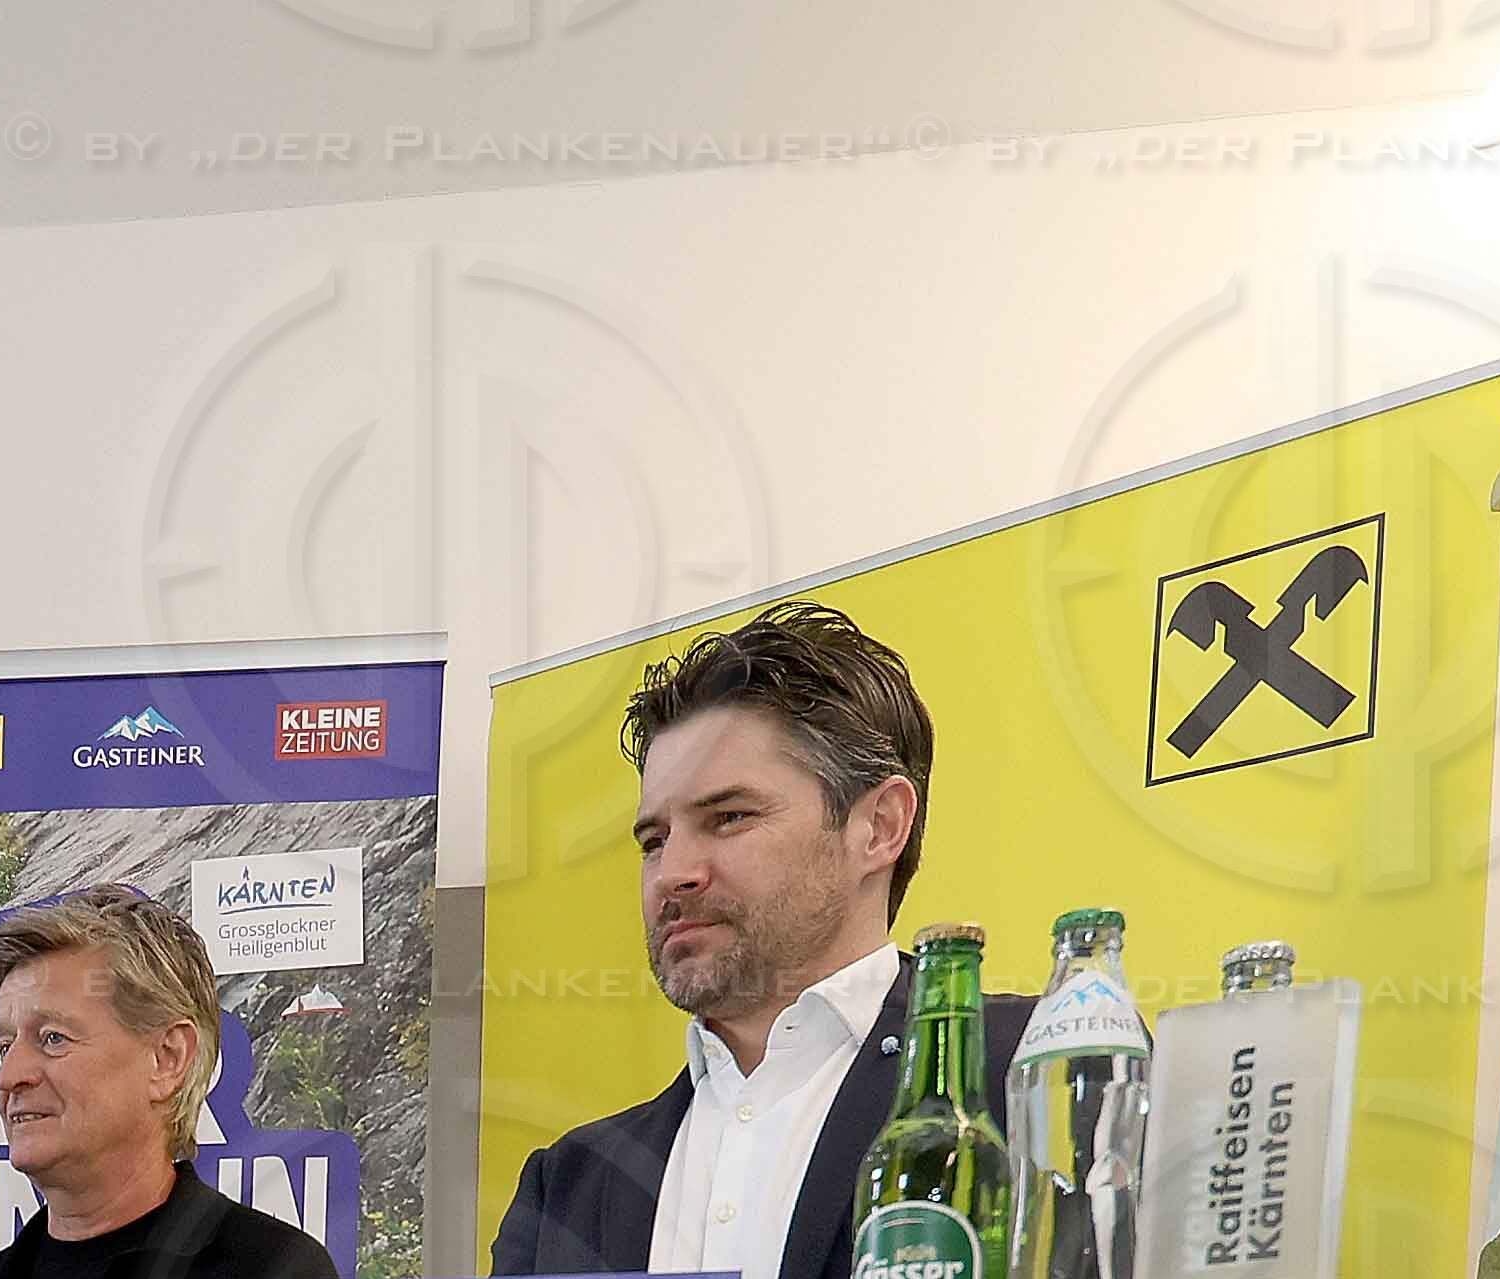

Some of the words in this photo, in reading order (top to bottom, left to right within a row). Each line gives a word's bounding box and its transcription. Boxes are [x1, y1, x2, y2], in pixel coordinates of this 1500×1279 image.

[281, 706, 381, 730] KLEINE
[281, 730, 380, 755] ZEITUNG
[73, 744, 206, 769] GASTEINER
[218, 917, 336, 941] Grossglockner
[228, 936, 328, 958] Heiligenblut
[1026, 1015, 1143, 1045] GASTEINE
[1206, 1045, 1257, 1266] Raiffeisen
[1245, 1080, 1296, 1263] Kärnten
